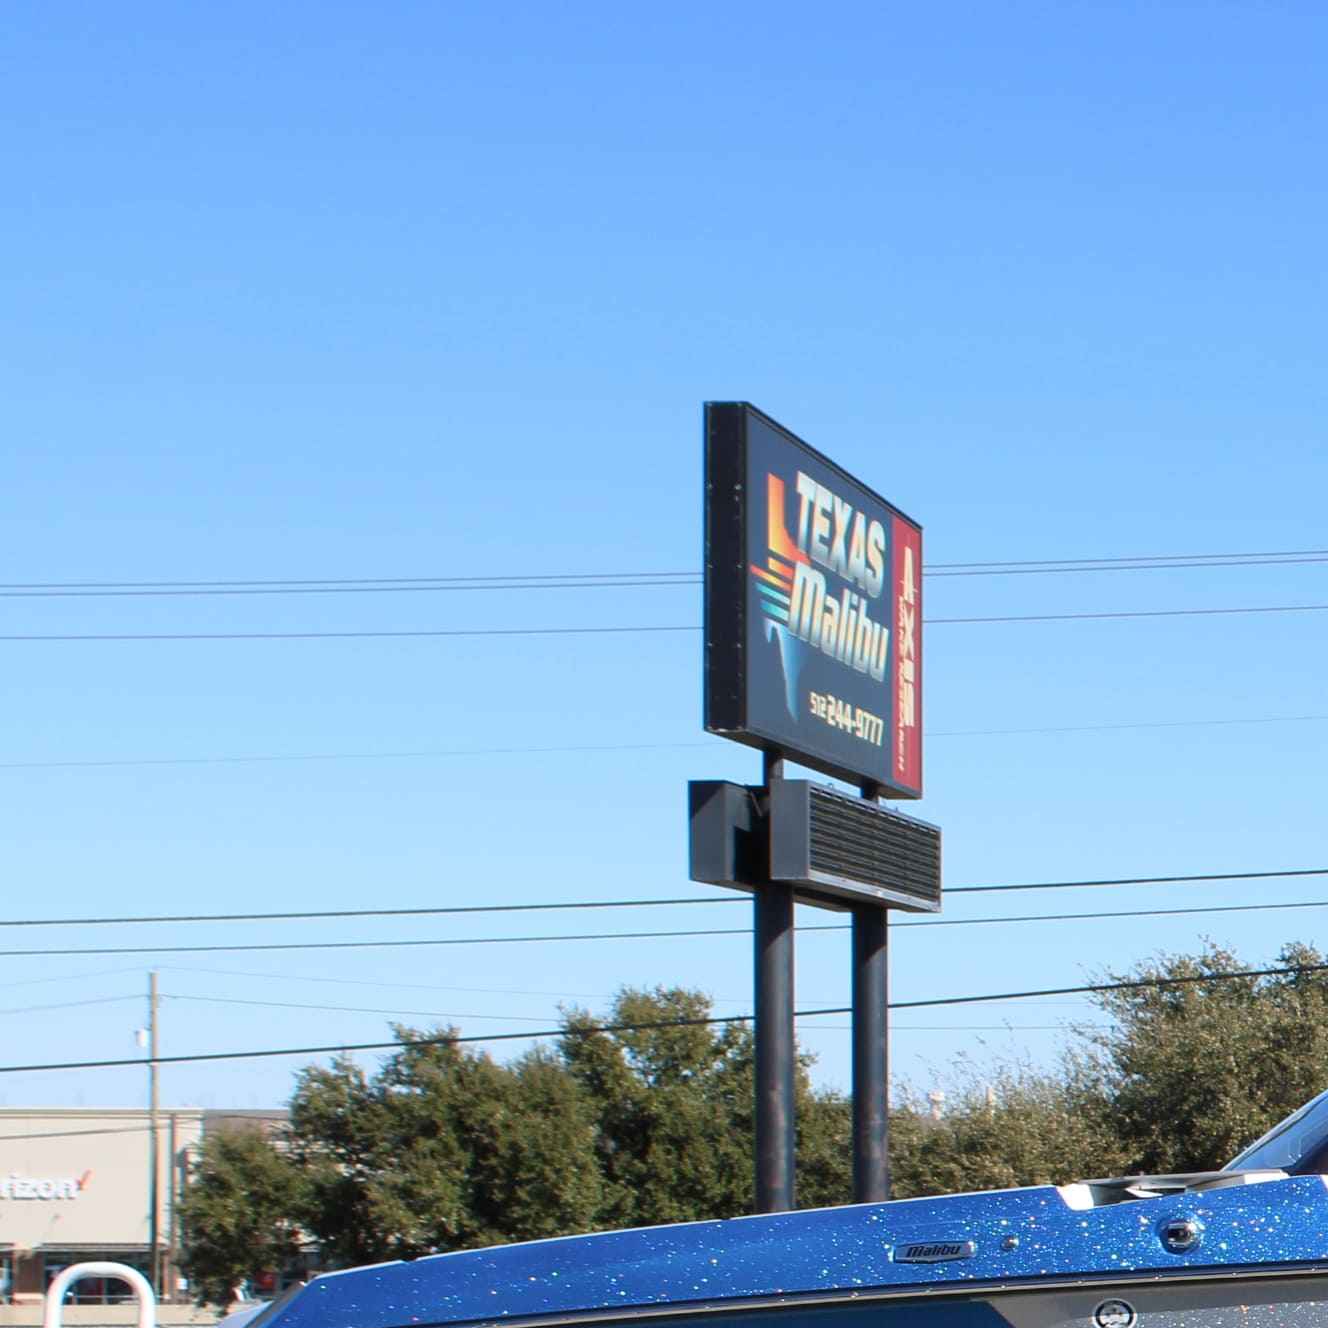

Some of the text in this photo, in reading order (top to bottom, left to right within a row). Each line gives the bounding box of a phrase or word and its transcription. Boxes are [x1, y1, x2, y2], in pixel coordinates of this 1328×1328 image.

[797, 471, 885, 598] TEXAS
[788, 562, 889, 682] Malibu
[905, 1245, 961, 1258] Malibu
